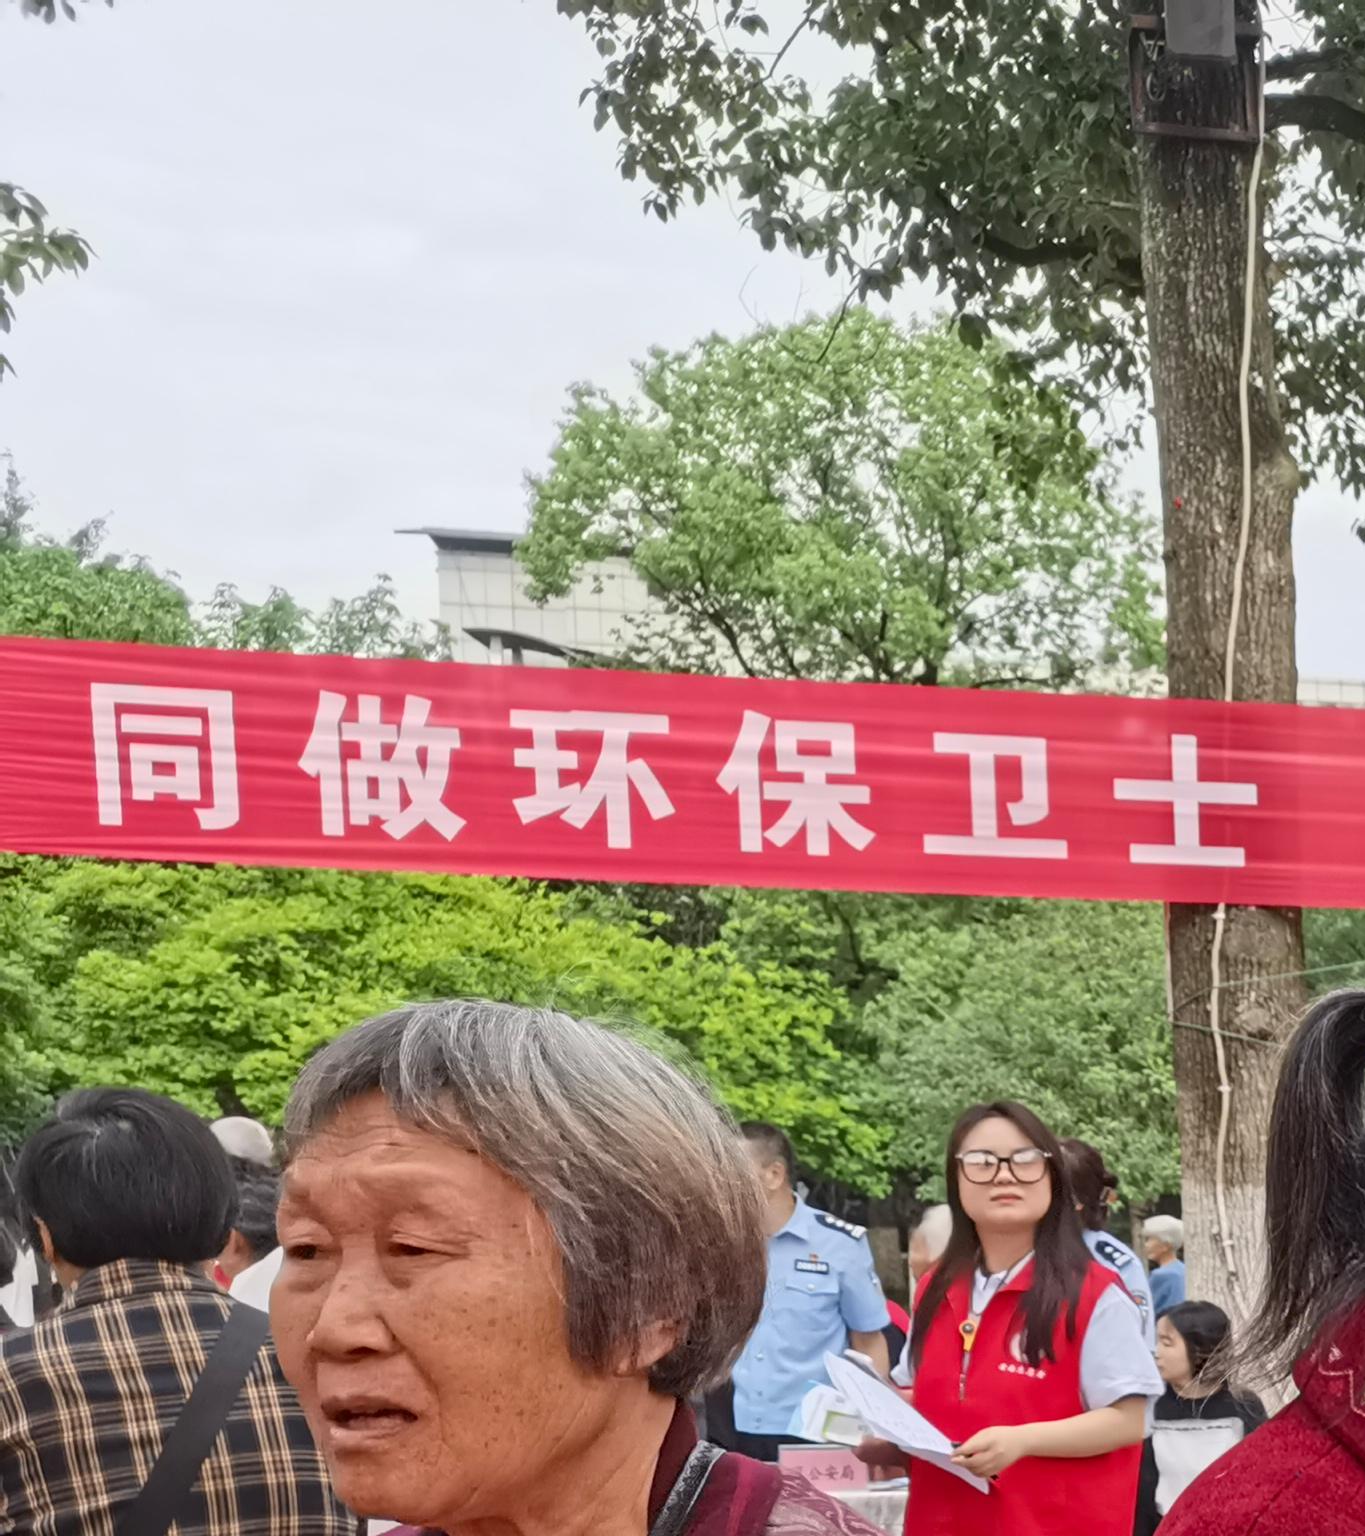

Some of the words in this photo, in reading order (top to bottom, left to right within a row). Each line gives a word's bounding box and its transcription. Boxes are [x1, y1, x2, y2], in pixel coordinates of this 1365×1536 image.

[89, 681, 1260, 869] 同做环保卫士
